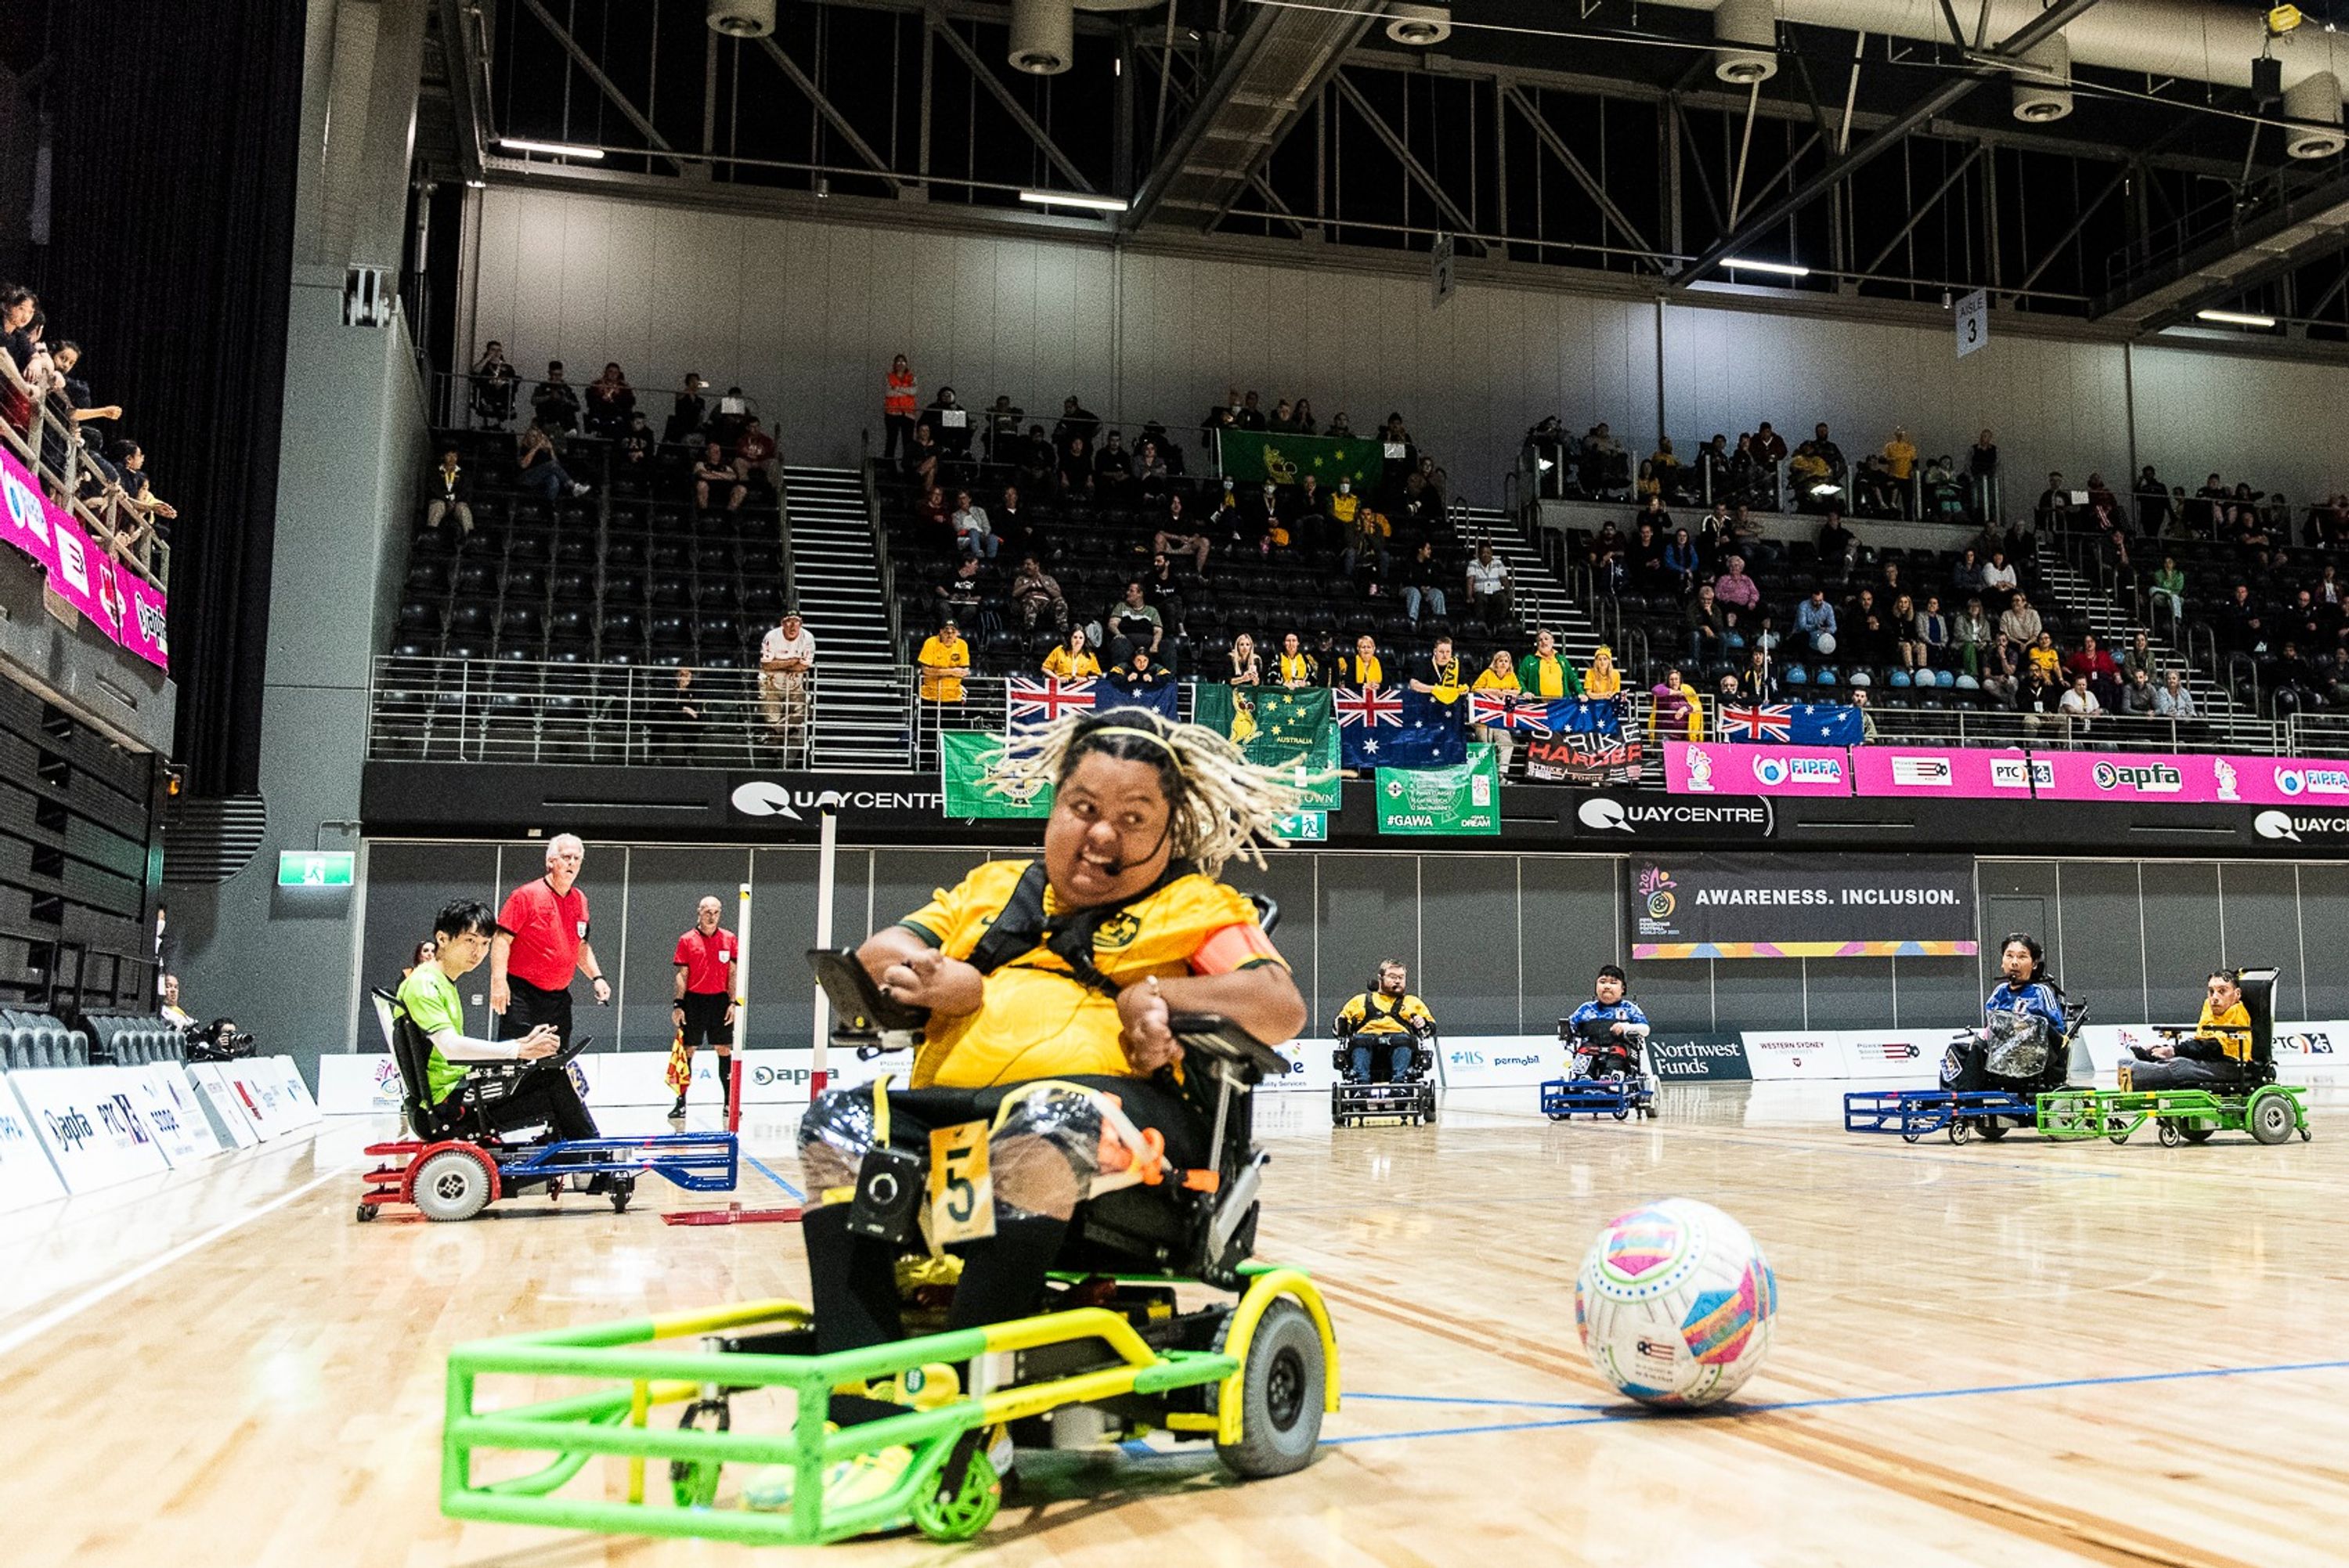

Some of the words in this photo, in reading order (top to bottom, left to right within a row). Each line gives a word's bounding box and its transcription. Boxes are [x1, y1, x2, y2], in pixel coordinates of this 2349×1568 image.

[1439, 268, 1446, 295] 2
[1968, 319, 1977, 344] 3
[1276, 736, 1313, 744] AUSTRALIA
[1792, 759, 1841, 774] FIPFA
[1997, 766, 2019, 777] PTC
[2118, 764, 2181, 790] apfa
[2307, 771, 2349, 786] FIPFA
[1387, 815, 1434, 827] #GAWA
[1460, 819, 1491, 827] DREAM
[1695, 889, 1835, 905] AWARENESS.
[1842, 889, 1961, 905] INCLUSION.
[1651, 1041, 1741, 1058] Northwest
[1494, 1054, 1540, 1066] permobil
[1655, 1058, 1709, 1074] Funds
[947, 1147, 976, 1223] 5
